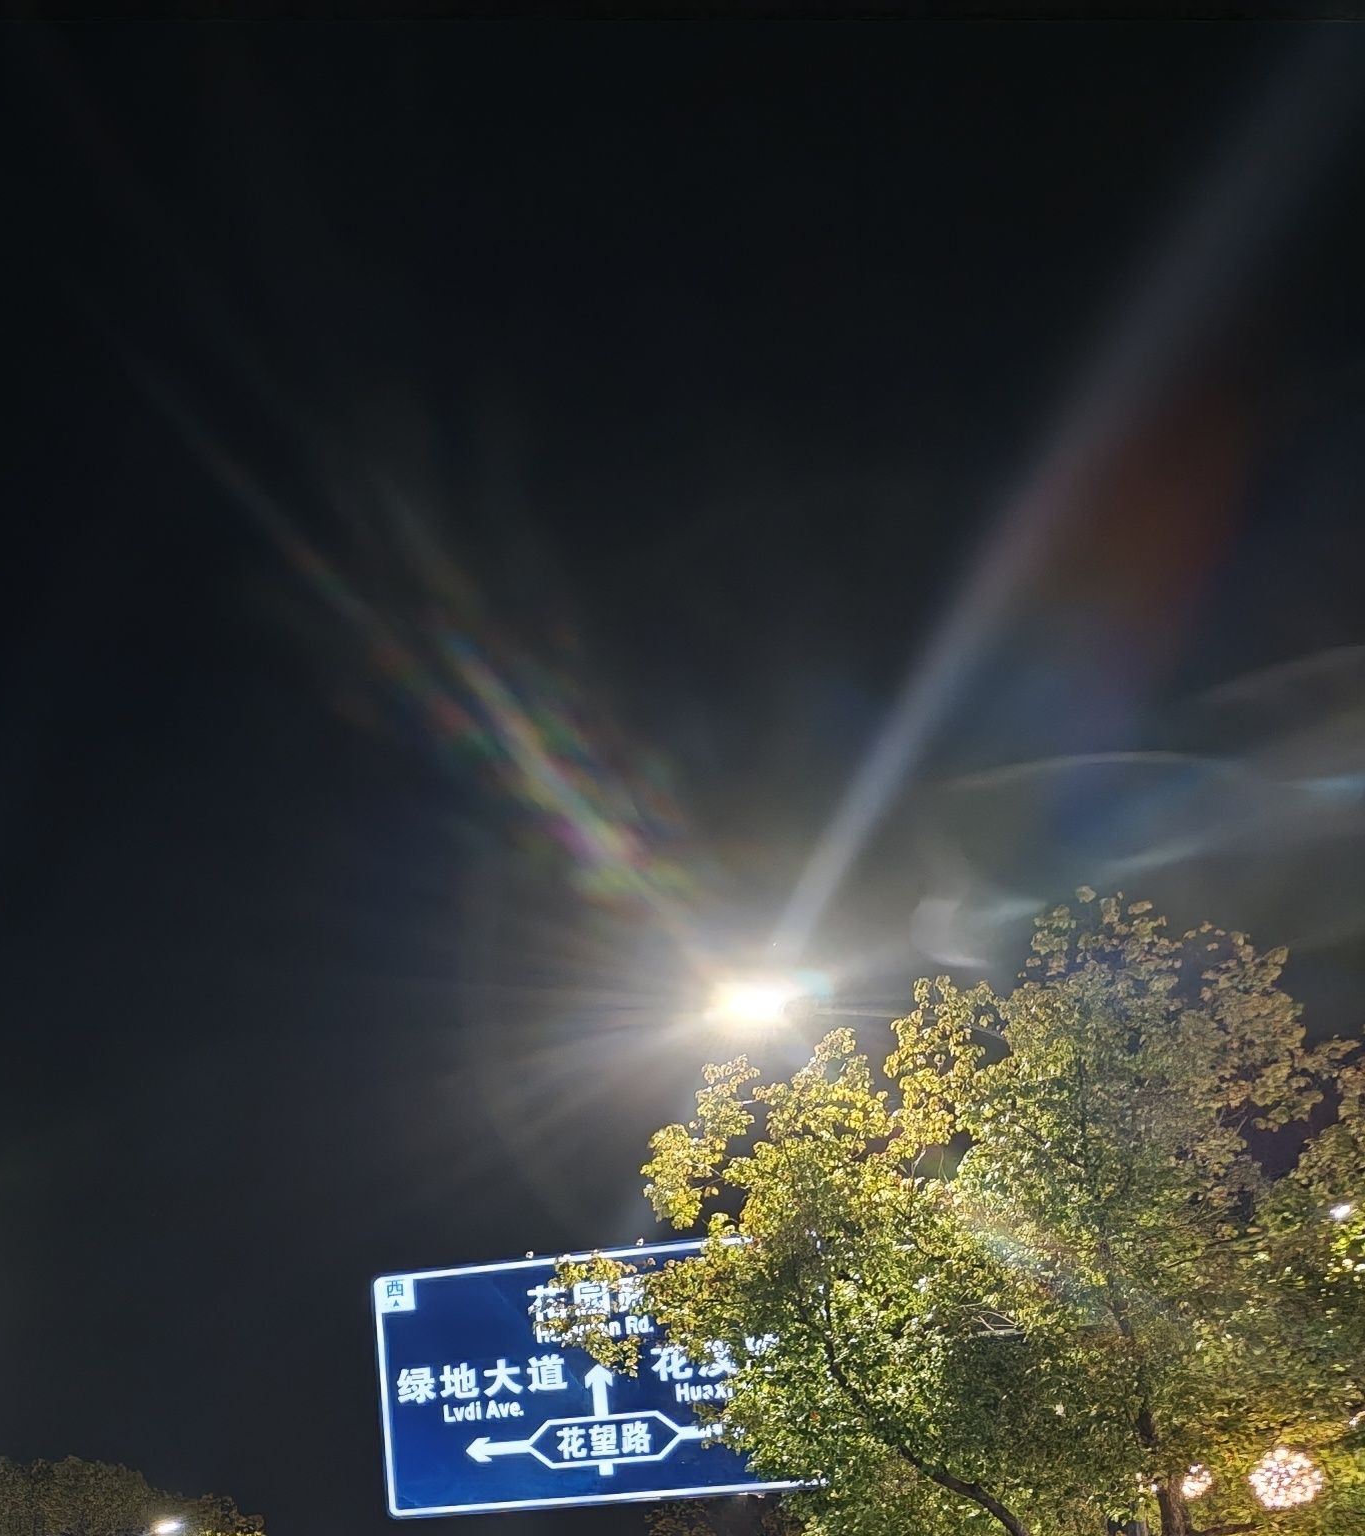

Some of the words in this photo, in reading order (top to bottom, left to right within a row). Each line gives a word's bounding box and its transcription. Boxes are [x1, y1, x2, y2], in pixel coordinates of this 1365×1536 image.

[385, 1279, 404, 1298] 西
[625, 1316, 654, 1335] Rd.
[396, 1354, 568, 1404] 绿地大道
[443, 1401, 482, 1422] Lvdi
[486, 1399, 524, 1419] Ave.
[556, 1421, 651, 1459] 花望路
